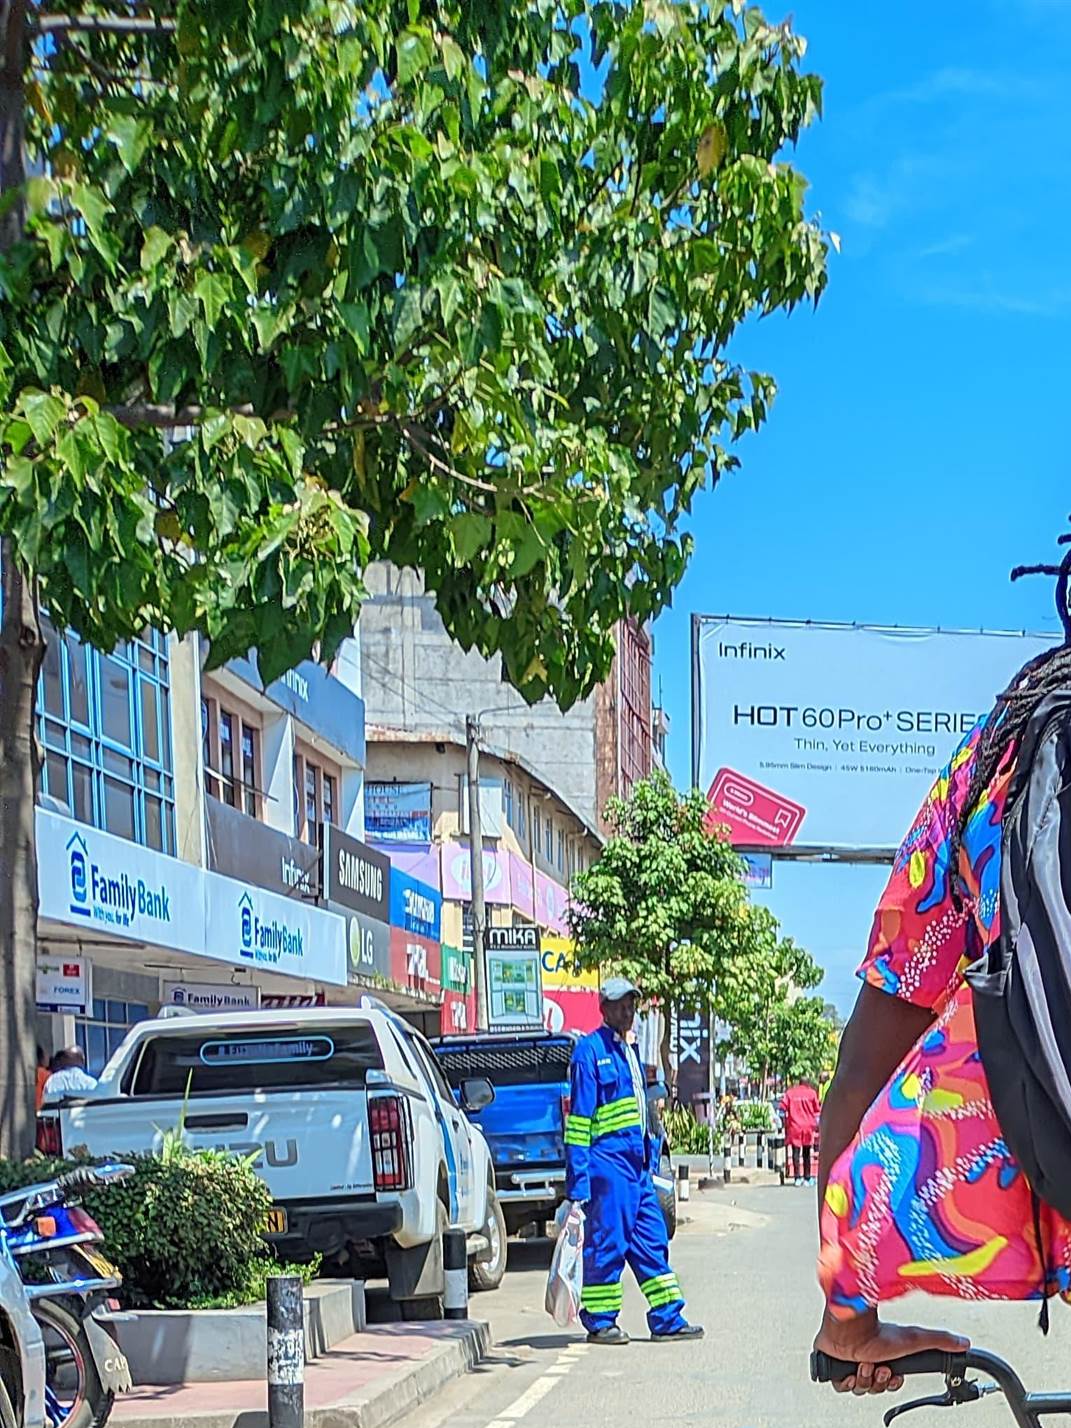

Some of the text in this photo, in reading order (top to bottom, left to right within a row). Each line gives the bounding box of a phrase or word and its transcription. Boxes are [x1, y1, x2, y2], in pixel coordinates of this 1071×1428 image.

[719, 641, 785, 660] Infinix
[734, 704, 798, 727] HOT
[896, 711, 987, 733] SERIE
[794, 737, 936, 756] Thin, Yet Everything
[338, 849, 383, 902] SAMSUNG
[361, 927, 373, 965] LG
[489, 929, 536, 945] MIKA
